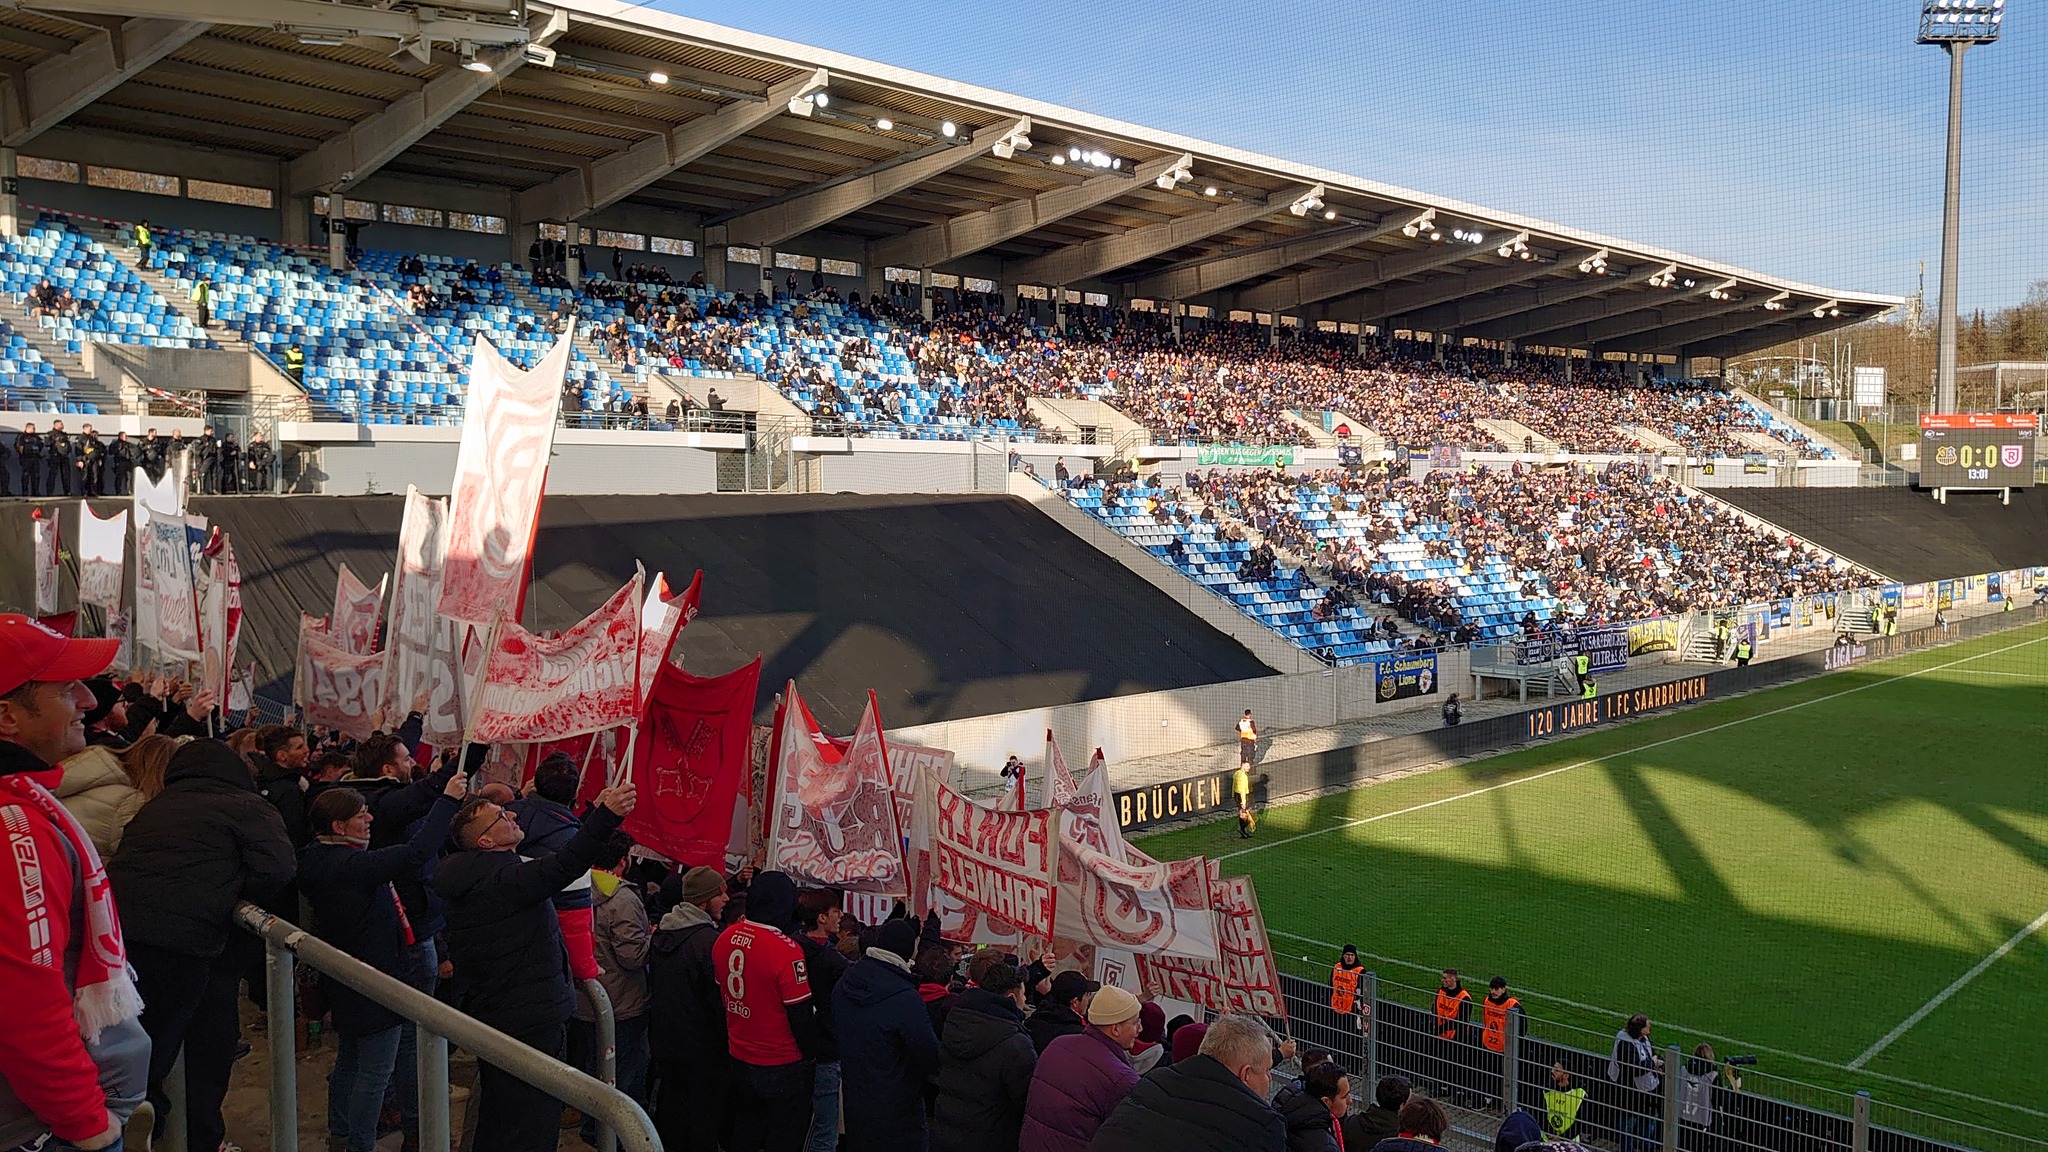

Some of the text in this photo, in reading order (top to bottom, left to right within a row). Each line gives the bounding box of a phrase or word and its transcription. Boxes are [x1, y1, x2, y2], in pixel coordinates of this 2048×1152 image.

[1968, 468, 1989, 480] 13:01
[1394, 657, 1435, 673] Schaumberg
[1398, 674, 1417, 687] Lions
[1529, 677, 1706, 737] 120 JAHRE 1.FC SAARBRÜCKEN
[1120, 777, 1221, 827] BRÜCKEN
[730, 934, 752, 949] GEIPL
[727, 949, 745, 1000] 8
